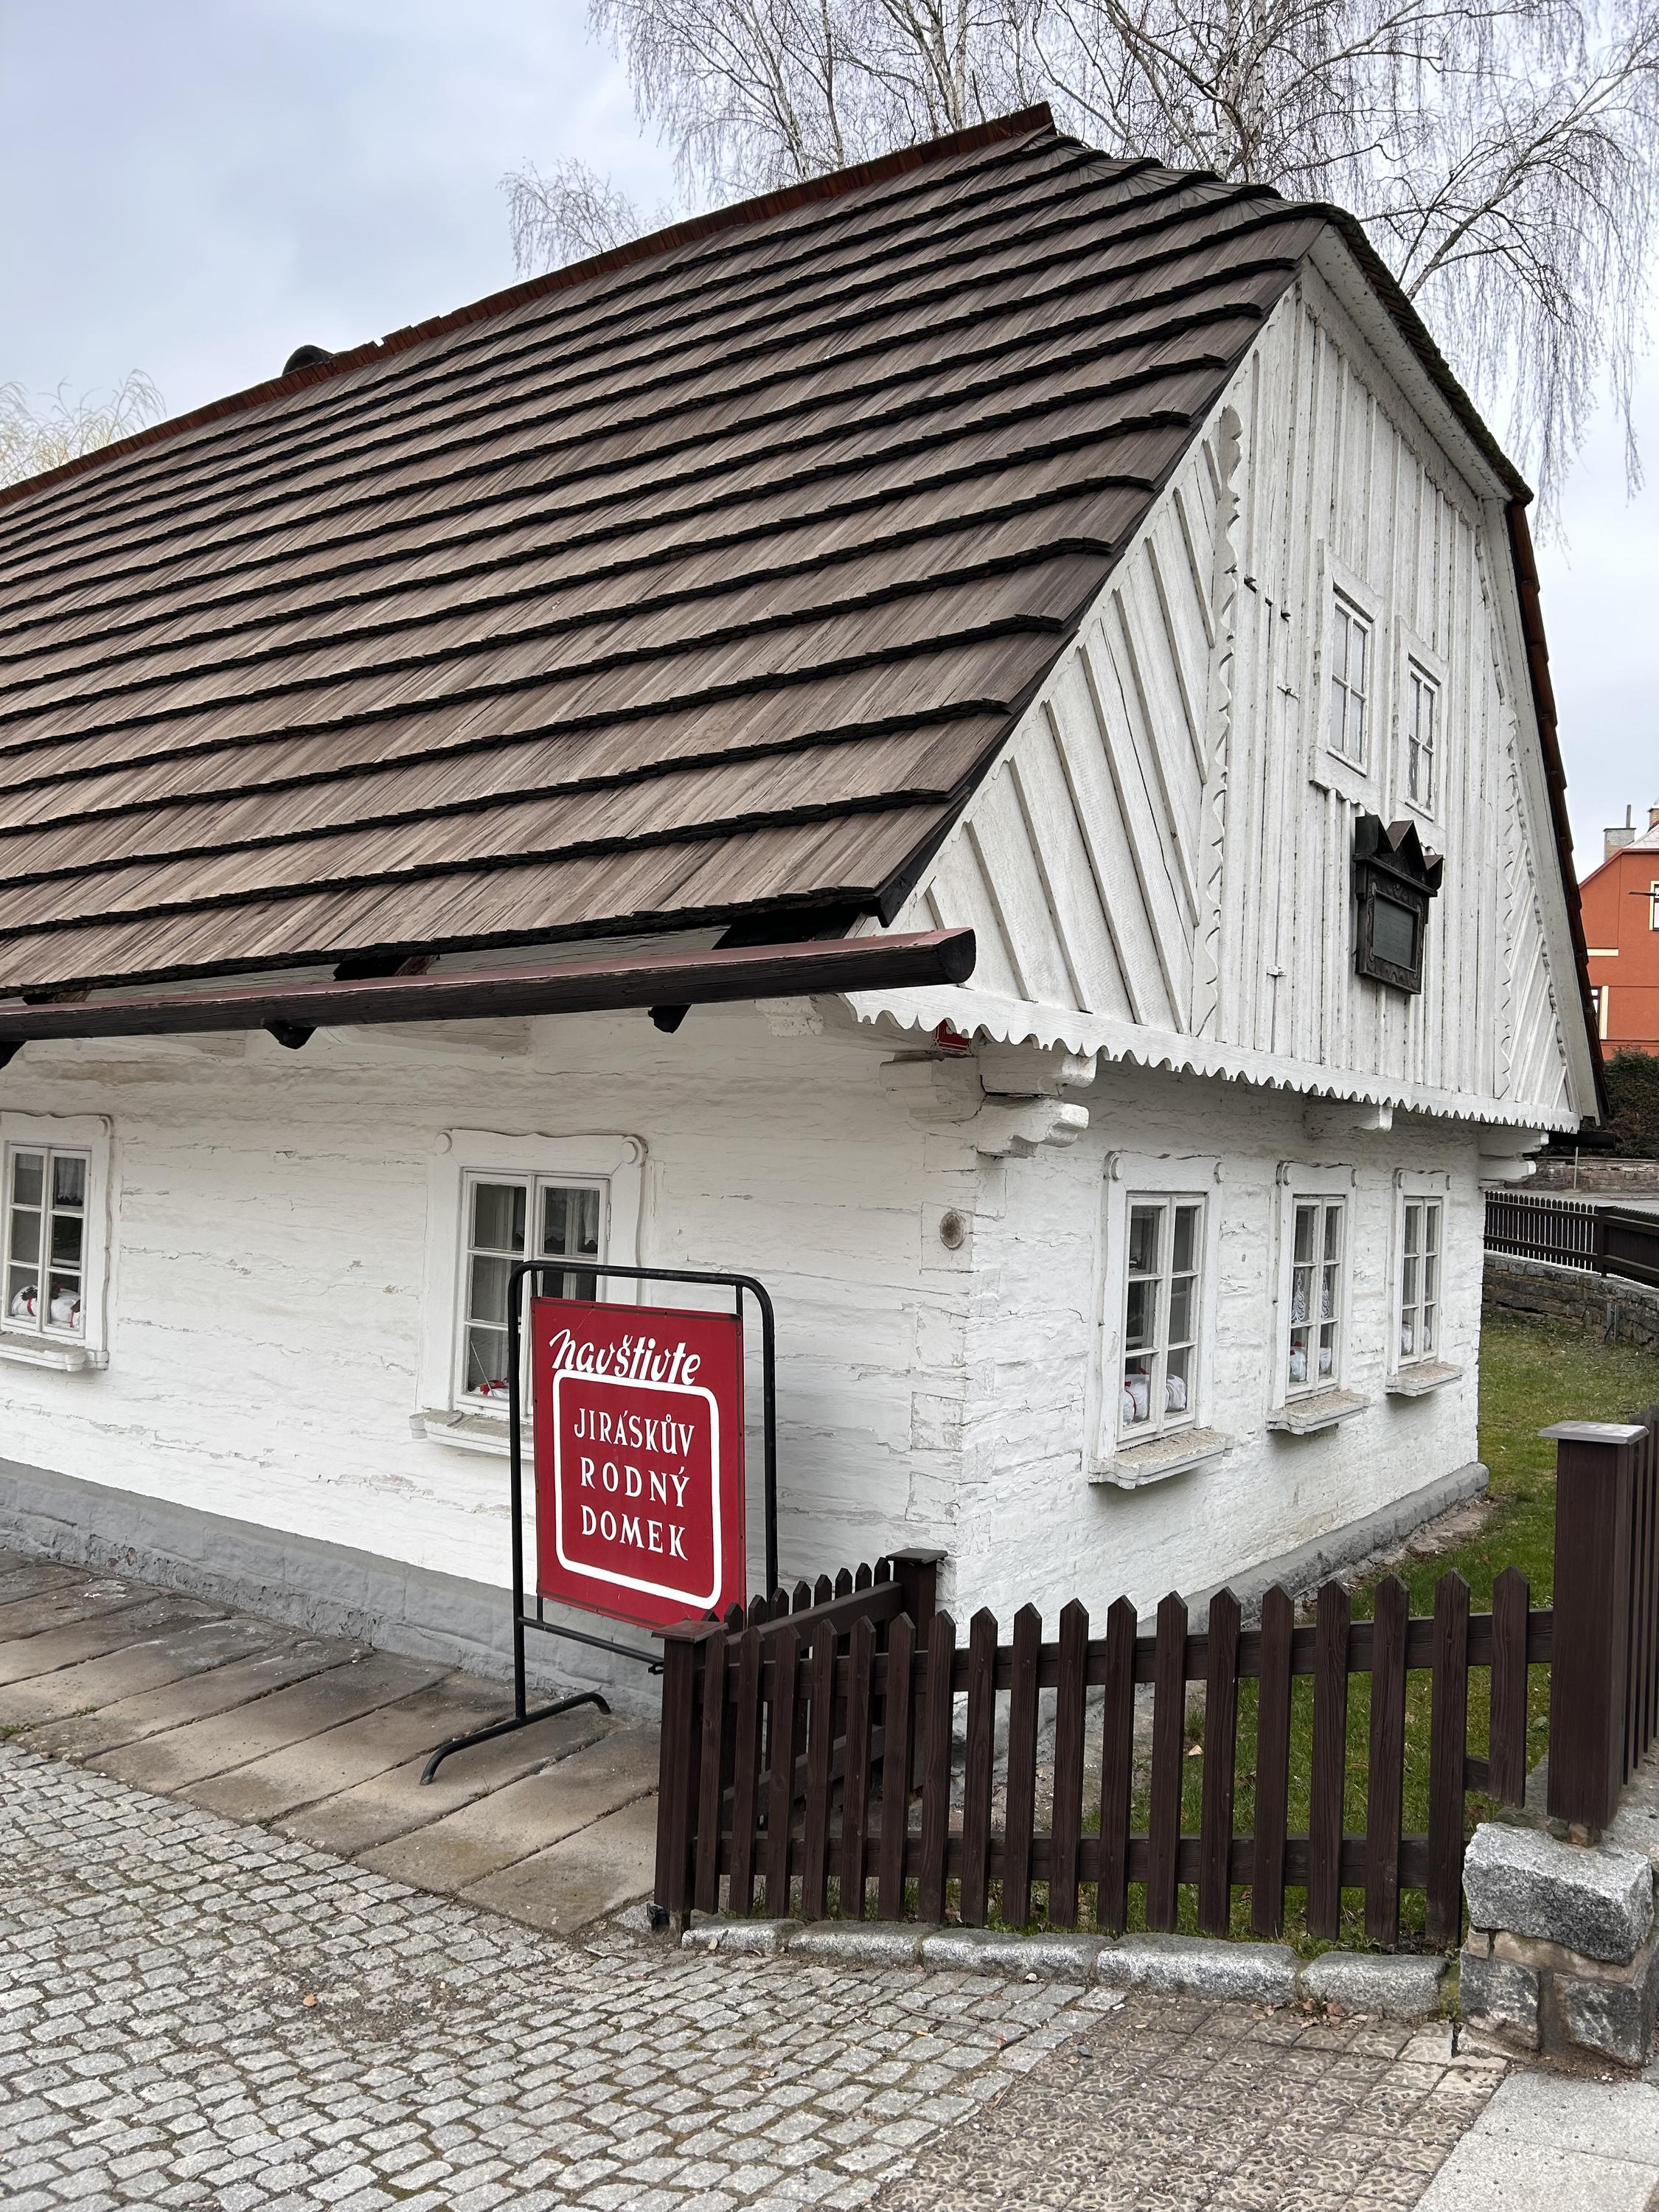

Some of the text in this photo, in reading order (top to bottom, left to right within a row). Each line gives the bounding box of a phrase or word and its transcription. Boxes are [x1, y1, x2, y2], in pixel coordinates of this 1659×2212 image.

[574, 1408, 695, 1457] JIRÁSKŮV
[580, 1457, 689, 1507] RODNÝ
[580, 1505, 688, 1560] DOMEK
